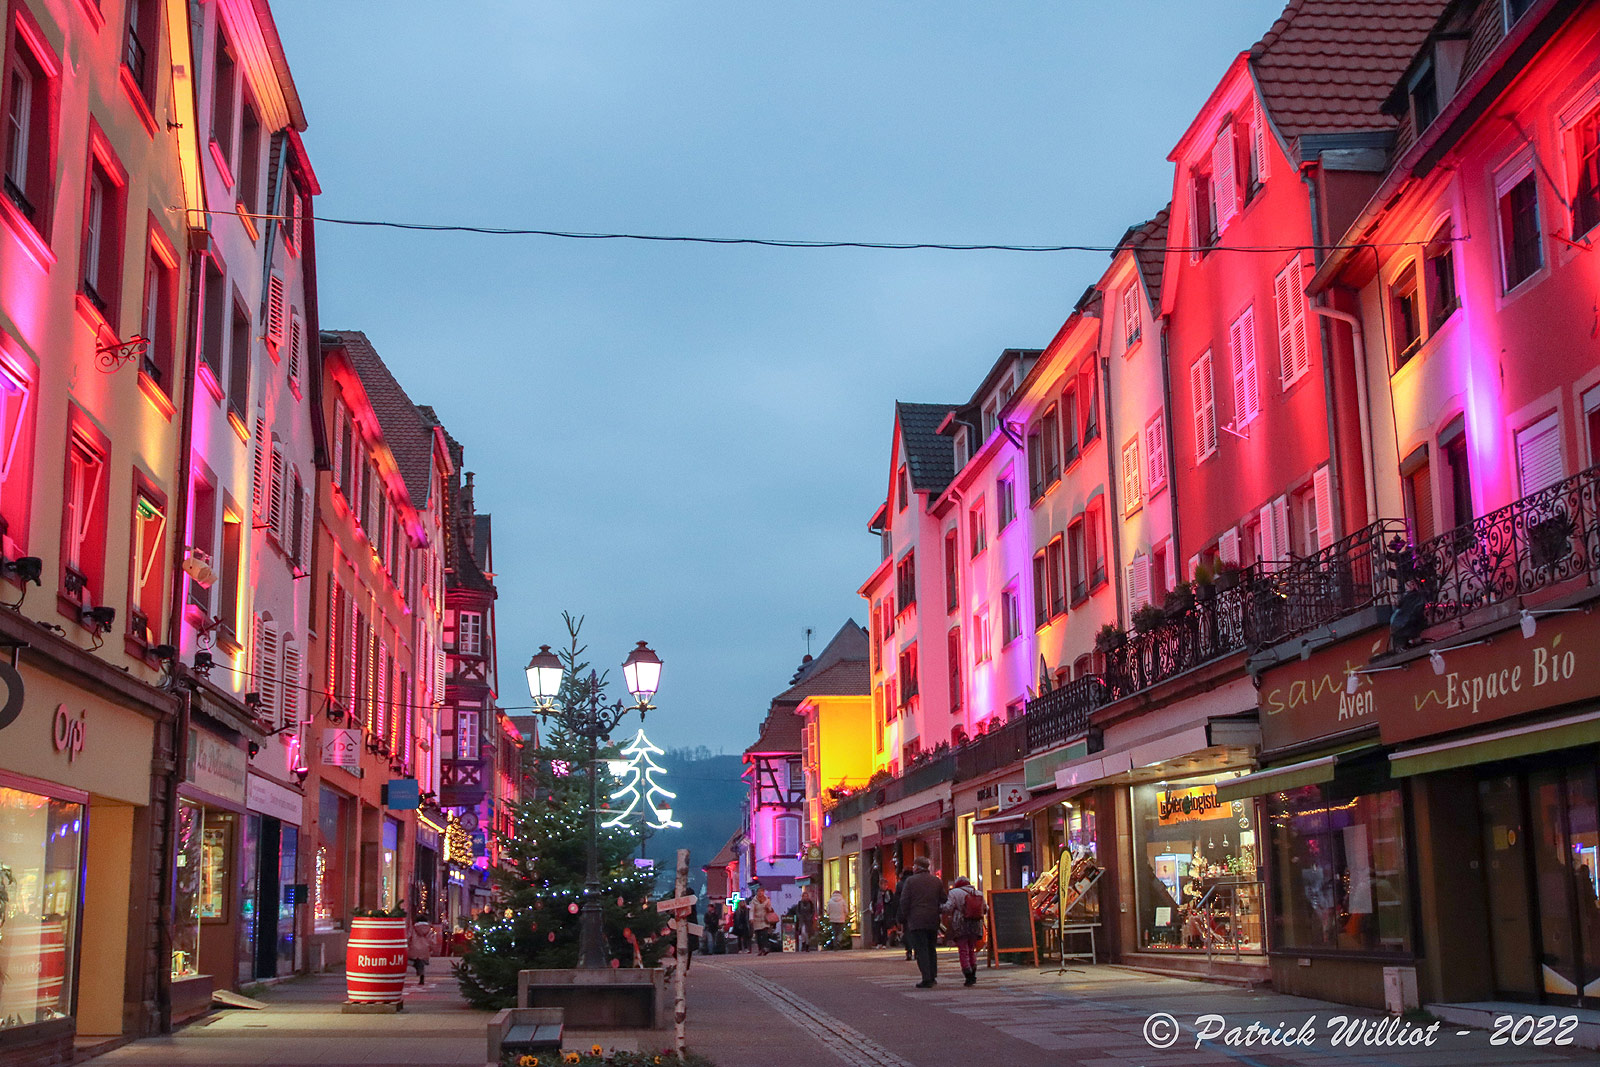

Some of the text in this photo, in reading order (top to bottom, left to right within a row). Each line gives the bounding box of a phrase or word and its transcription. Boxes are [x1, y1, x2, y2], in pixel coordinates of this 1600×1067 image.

[1446, 665, 1521, 713] Espace
[1532, 634, 1575, 687] Bio
[1338, 689, 1377, 721] Aven
[357, 954, 404, 968] Rhum J.M
